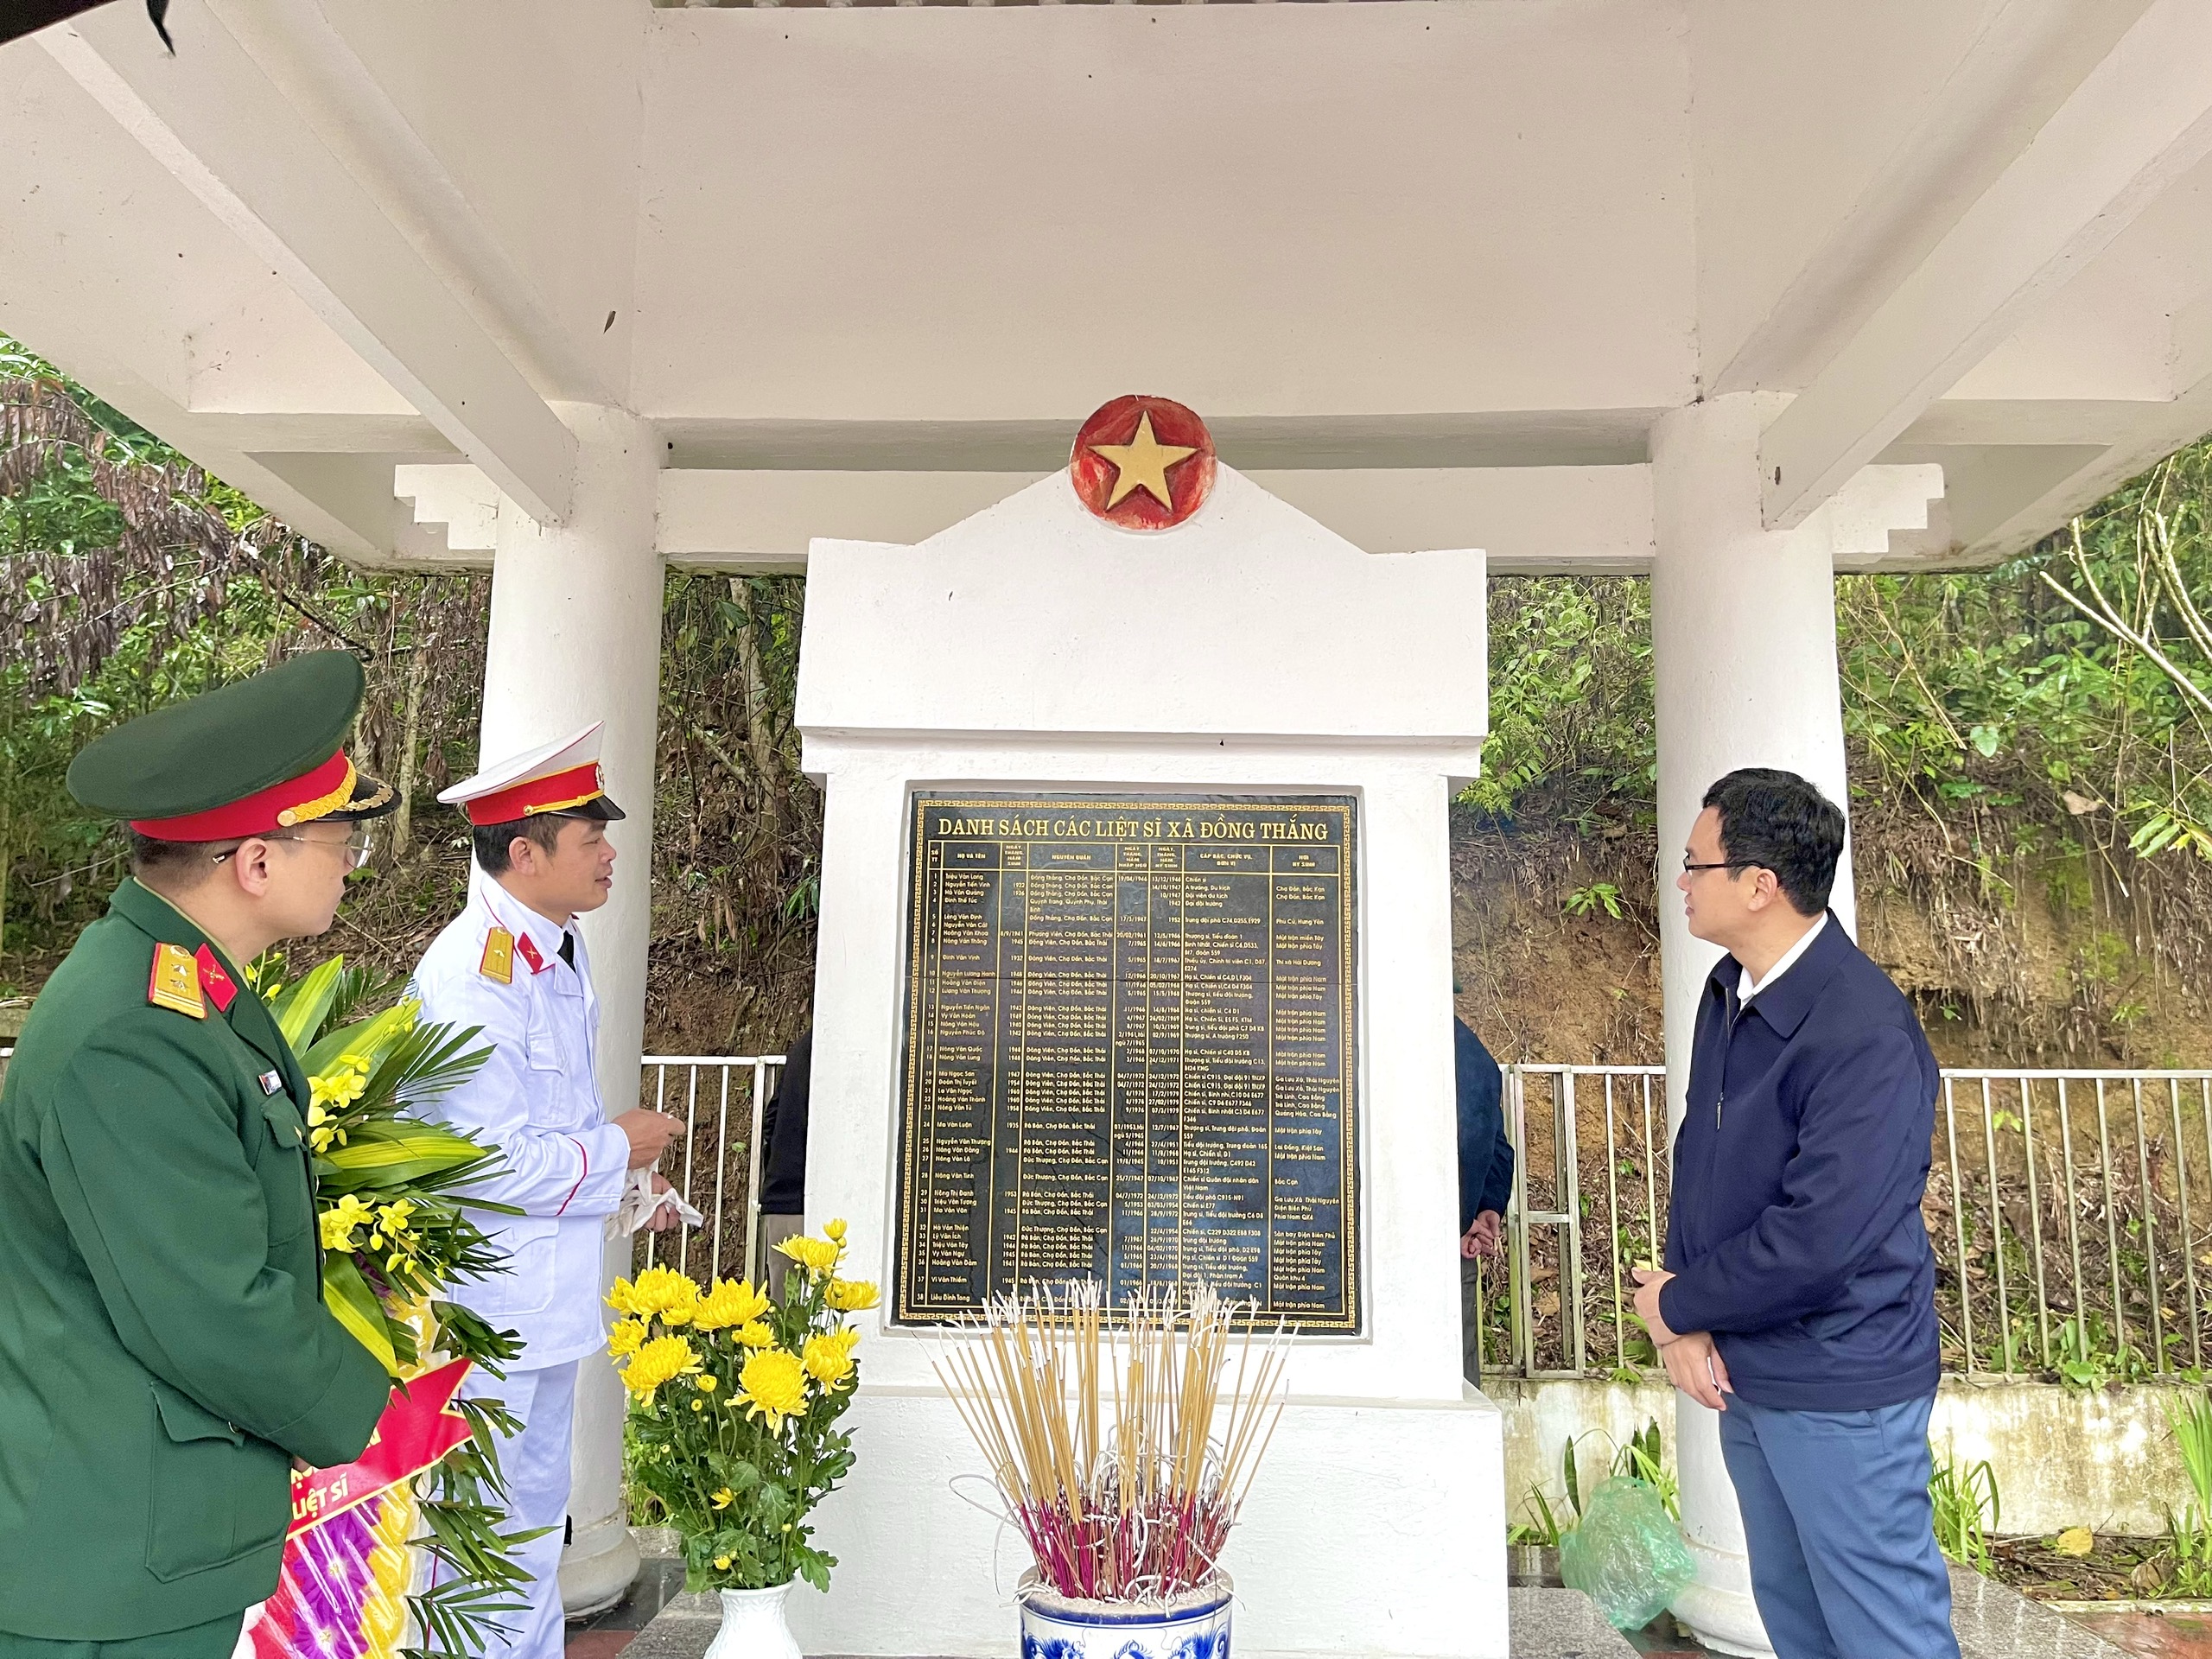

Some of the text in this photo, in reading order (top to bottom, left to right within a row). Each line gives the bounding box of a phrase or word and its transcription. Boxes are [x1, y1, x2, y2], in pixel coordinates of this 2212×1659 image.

[938, 813, 1329, 842] DANH SÁCH CÁC LIỆT SĨ XÃ ĐỒNG THẮNG
[945, 879, 966, 888] Nguyễn
[292, 1487, 327, 1520] LIỆT
